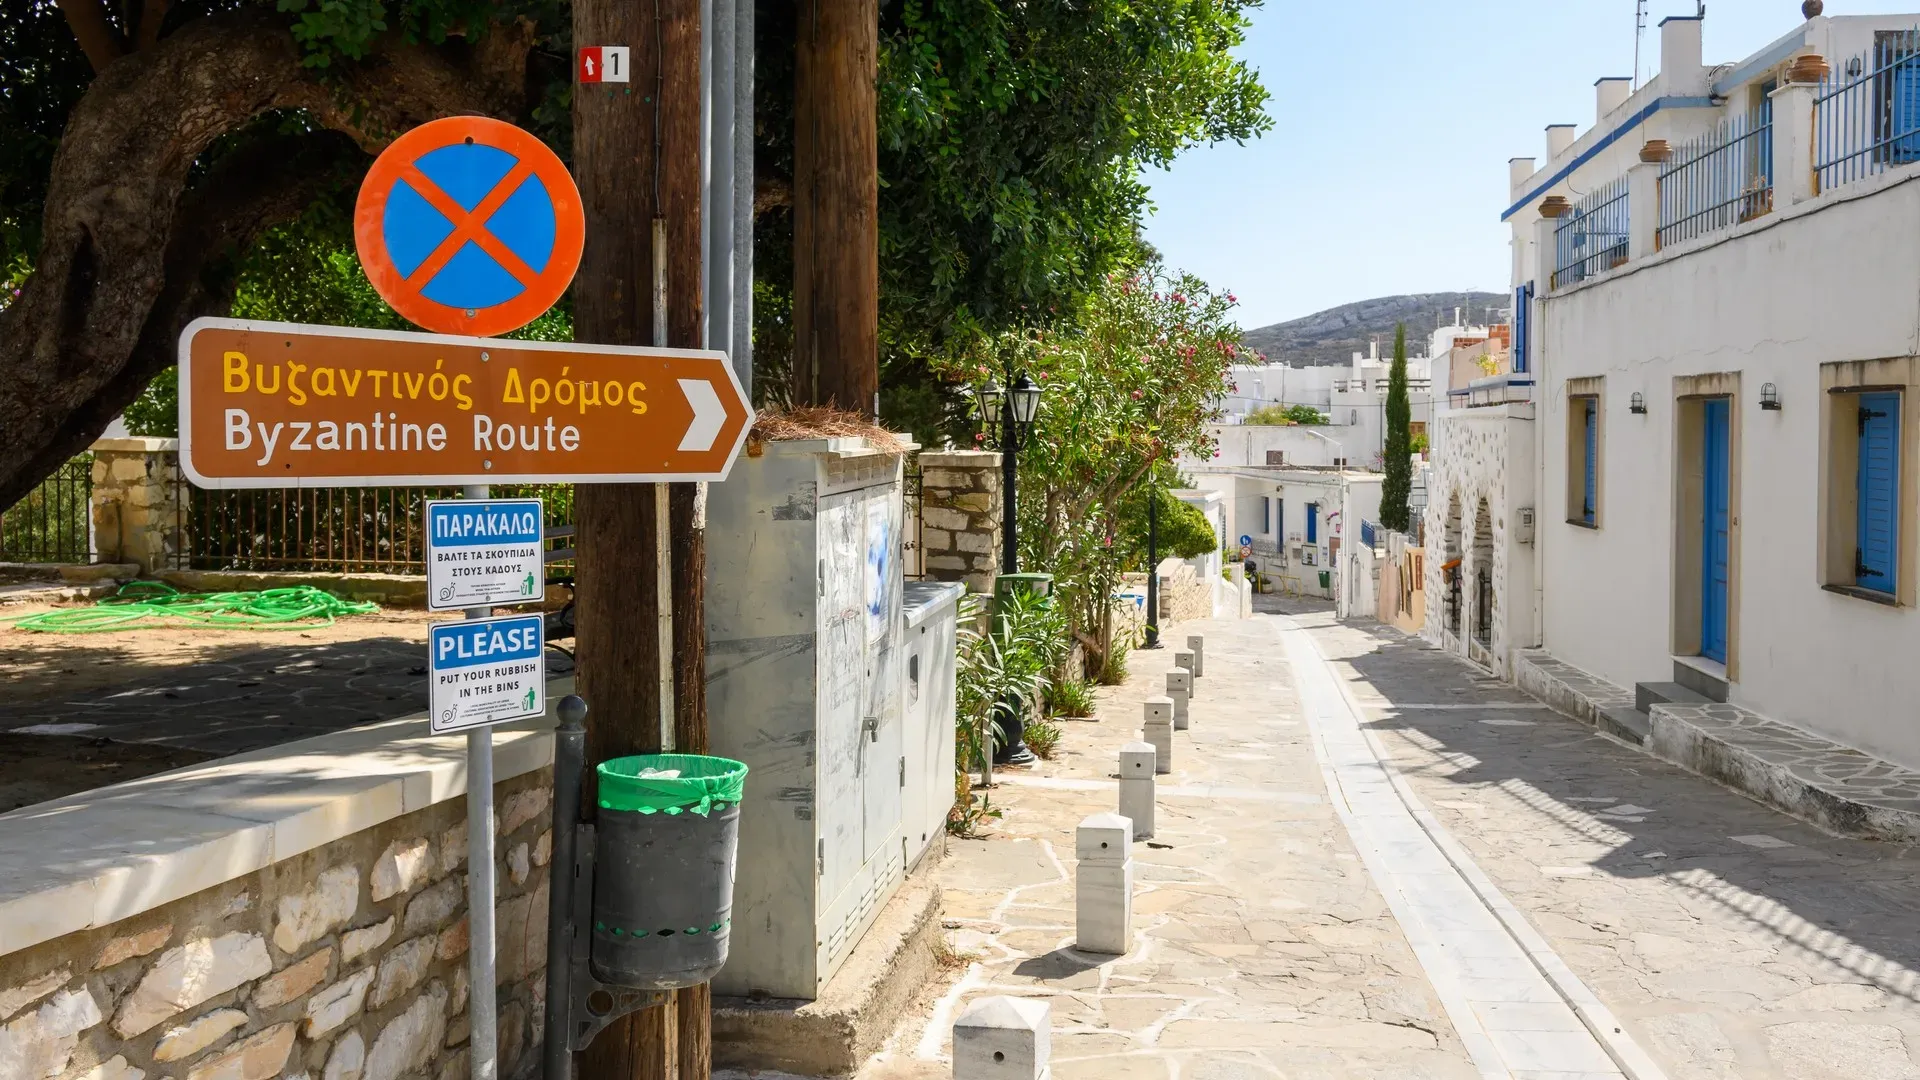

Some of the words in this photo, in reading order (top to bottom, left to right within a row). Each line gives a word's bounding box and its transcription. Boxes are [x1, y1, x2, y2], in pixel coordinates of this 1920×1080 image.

[610, 52, 619, 76] 1
[223, 351, 473, 411] Βυζαντινός
[502, 366, 648, 415] Δρόμος
[224, 408, 448, 467] Byzantine
[473, 414, 580, 452] Route
[436, 512, 535, 538] ΠΑΡΑΚΑΛΩ
[437, 551, 468, 562] ΒΑΛΤΕ
[471, 551, 483, 560] ΤΑ
[485, 548, 535, 560] ΣΚΟΥΠΙΔΙΑ
[452, 566, 483, 577] ΣΤΟΥΣ
[485, 564, 522, 575] ΚΑΔΟΥΣ
[439, 627, 536, 661] PLEASE
[440, 673, 460, 685] PUT
[463, 669, 491, 682] YOUR
[494, 663, 536, 678] RUBBISH
[459, 688, 471, 698] IN
[475, 685, 493, 696] THE
[496, 681, 520, 692] BINS
